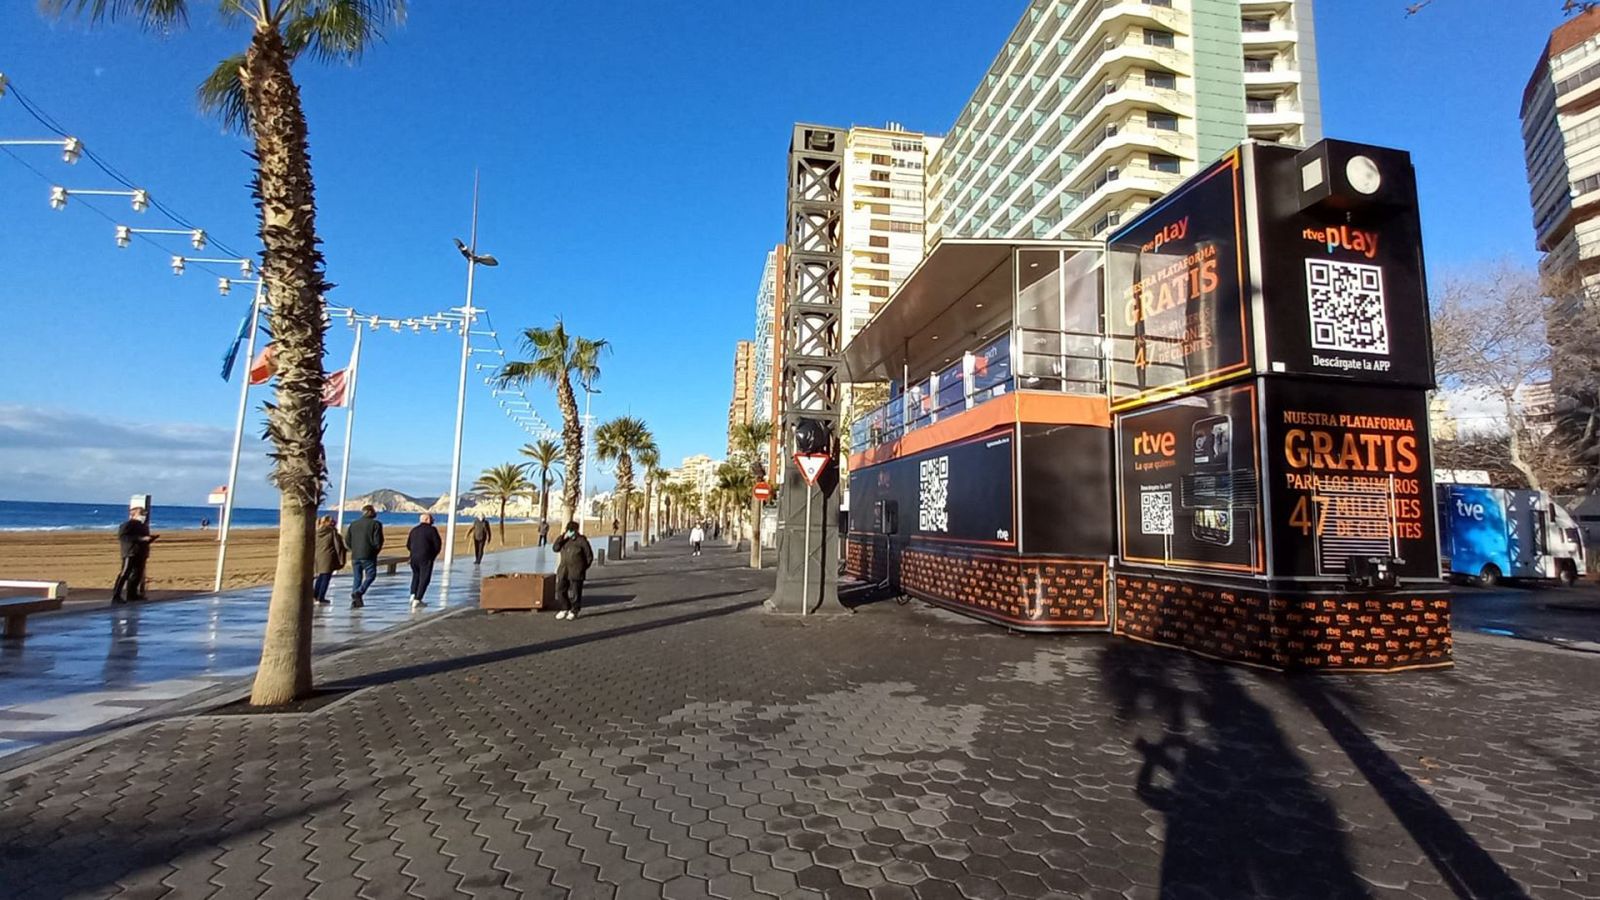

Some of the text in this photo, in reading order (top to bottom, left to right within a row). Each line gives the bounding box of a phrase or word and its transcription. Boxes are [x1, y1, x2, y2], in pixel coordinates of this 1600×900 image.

[1154, 216, 1189, 253] play
[1302, 225, 1380, 258] rtve play
[1125, 259, 1218, 327] GRATIS
[1312, 355, 1391, 371] Descárgate la APP
[1283, 411, 1414, 431] NUESTRA PLATAFORMA
[1134, 431, 1176, 456] rtve
[1285, 429, 1418, 473] GRATIS
[1286, 473, 1320, 490] PARA
[1289, 495, 1330, 536] 47
[1456, 499, 1484, 521] tve
